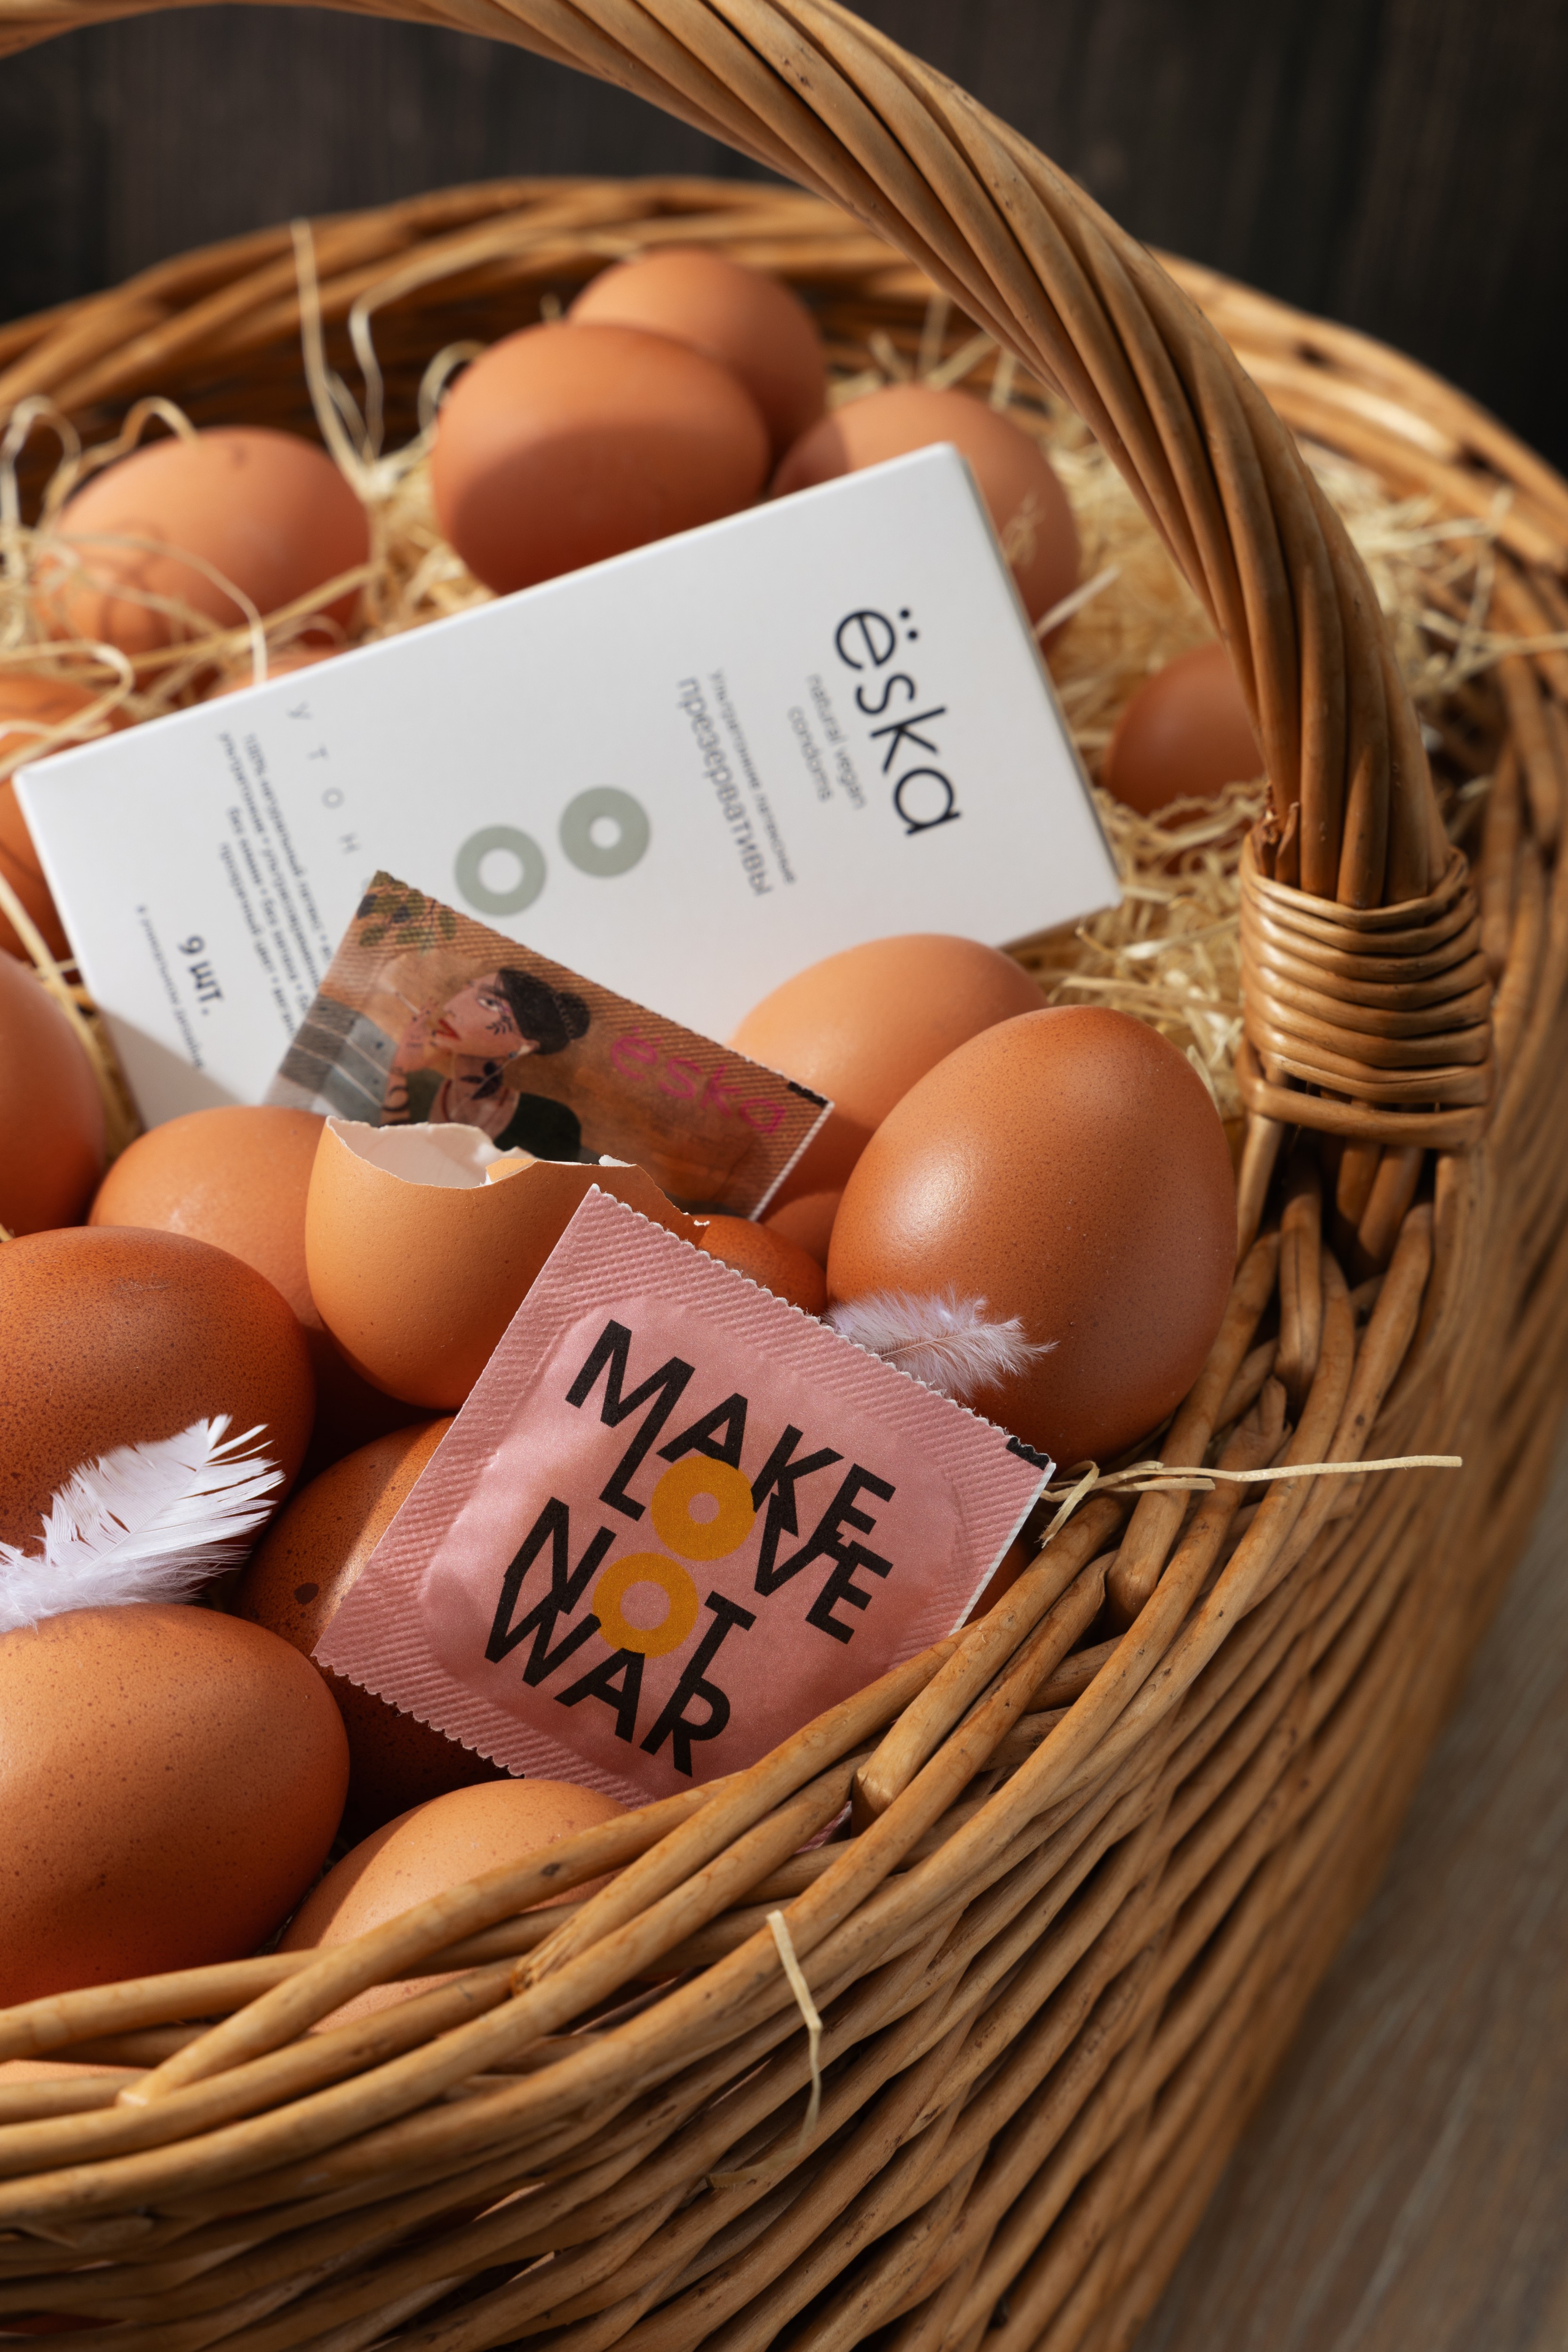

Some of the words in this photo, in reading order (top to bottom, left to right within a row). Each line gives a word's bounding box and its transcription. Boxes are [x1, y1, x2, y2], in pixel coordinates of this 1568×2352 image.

[219, 733, 266, 836] ультратонкие
[679, 678, 774, 896] презервативы
[788, 707, 834, 803] condoms
[808, 675, 847, 746] natural
[835, 748, 866, 809] vegan
[835, 608, 962, 836] ëska
[220, 843, 265, 938] прозрачный
[260, 778, 305, 879] натуральный
[297, 881, 323, 930] латекс
[756, 794, 796, 884] латексные
[178, 935, 205, 956] 9
[188, 961, 223, 1015] шт.
[609, 1025, 787, 1135] ëska
[565, 1319, 896, 1541] MAKE
[504, 1497, 756, 1688] NOT
[599, 1418, 893, 1644] LOVE
[485, 1572, 730, 1777] WAR
